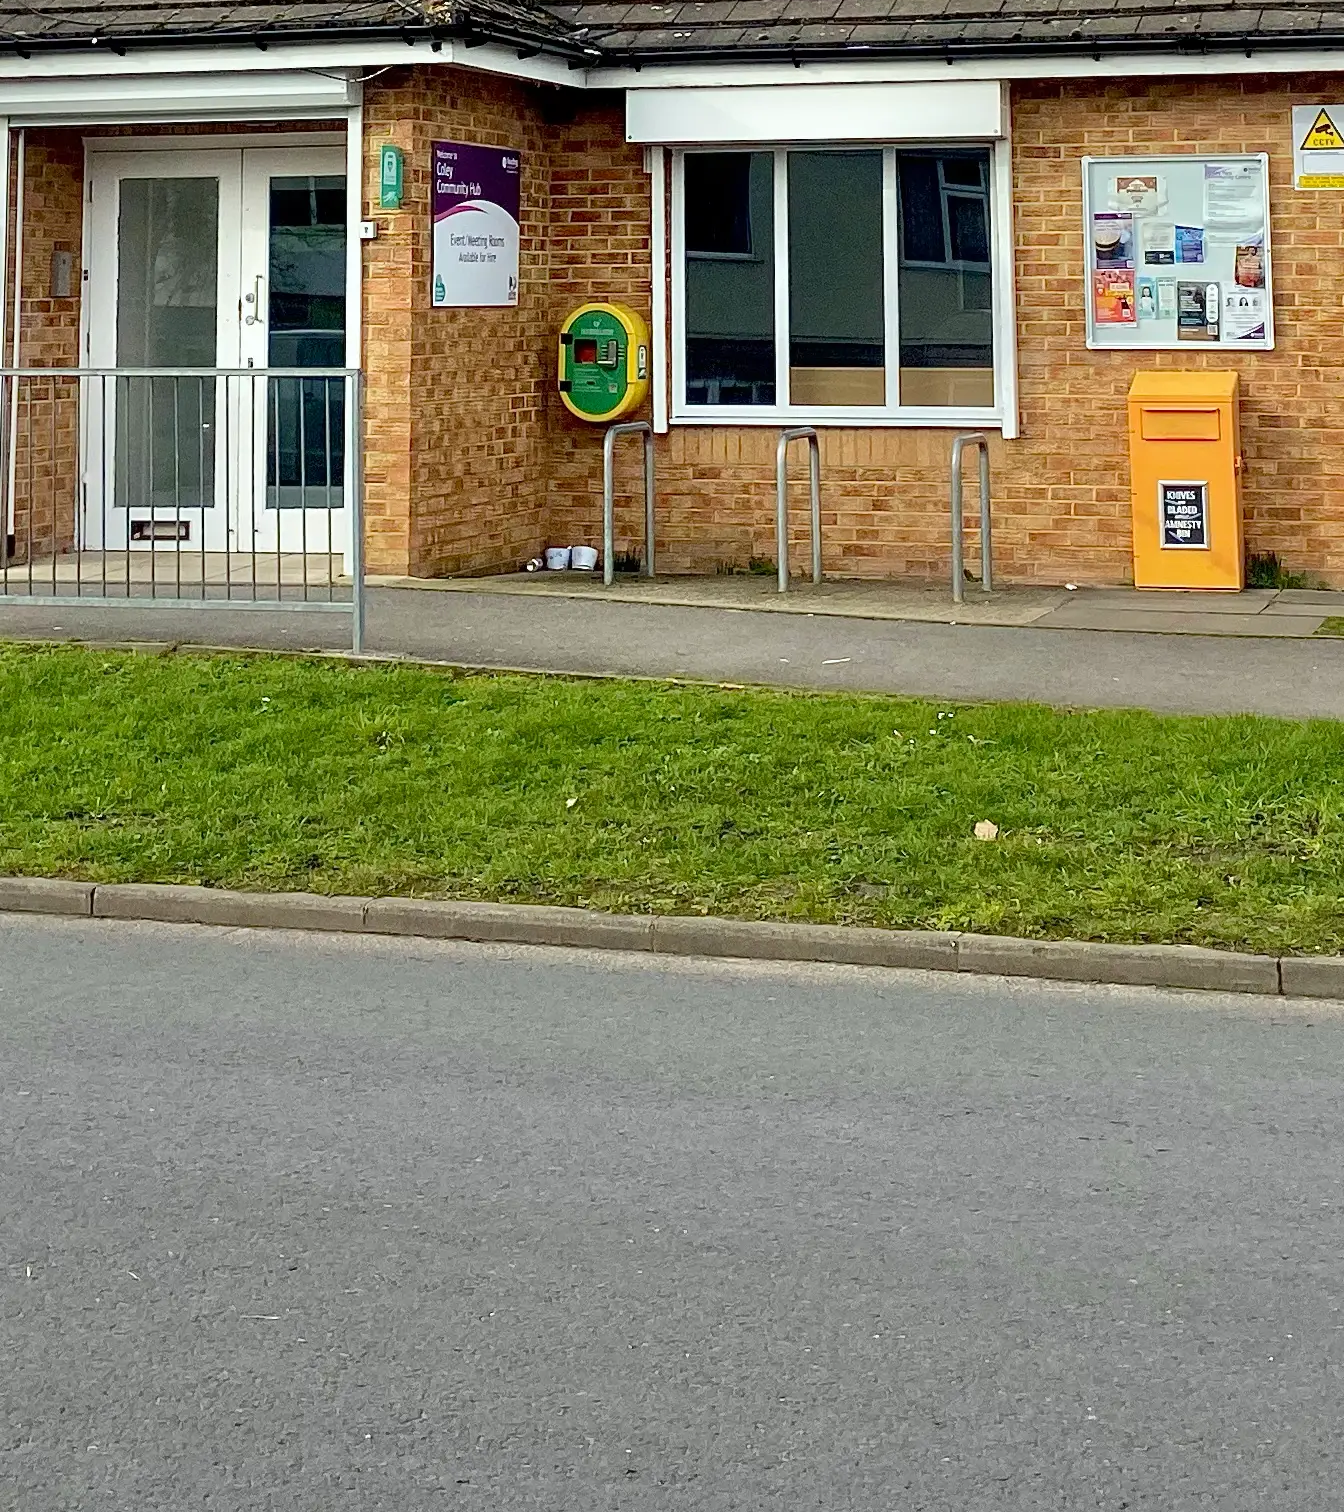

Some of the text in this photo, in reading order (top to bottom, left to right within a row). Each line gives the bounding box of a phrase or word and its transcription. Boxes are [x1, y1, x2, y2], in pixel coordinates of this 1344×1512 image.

[437, 162, 454, 179] Coley
[437, 179, 482, 198] Community Hub
[489, 234, 505, 247] Rooms
[459, 252, 479, 263] Available
[1167, 491, 1195, 499] KNIVES
[1168, 506, 1197, 514] BLADED
[1165, 520, 1201, 529] AMNESTY
